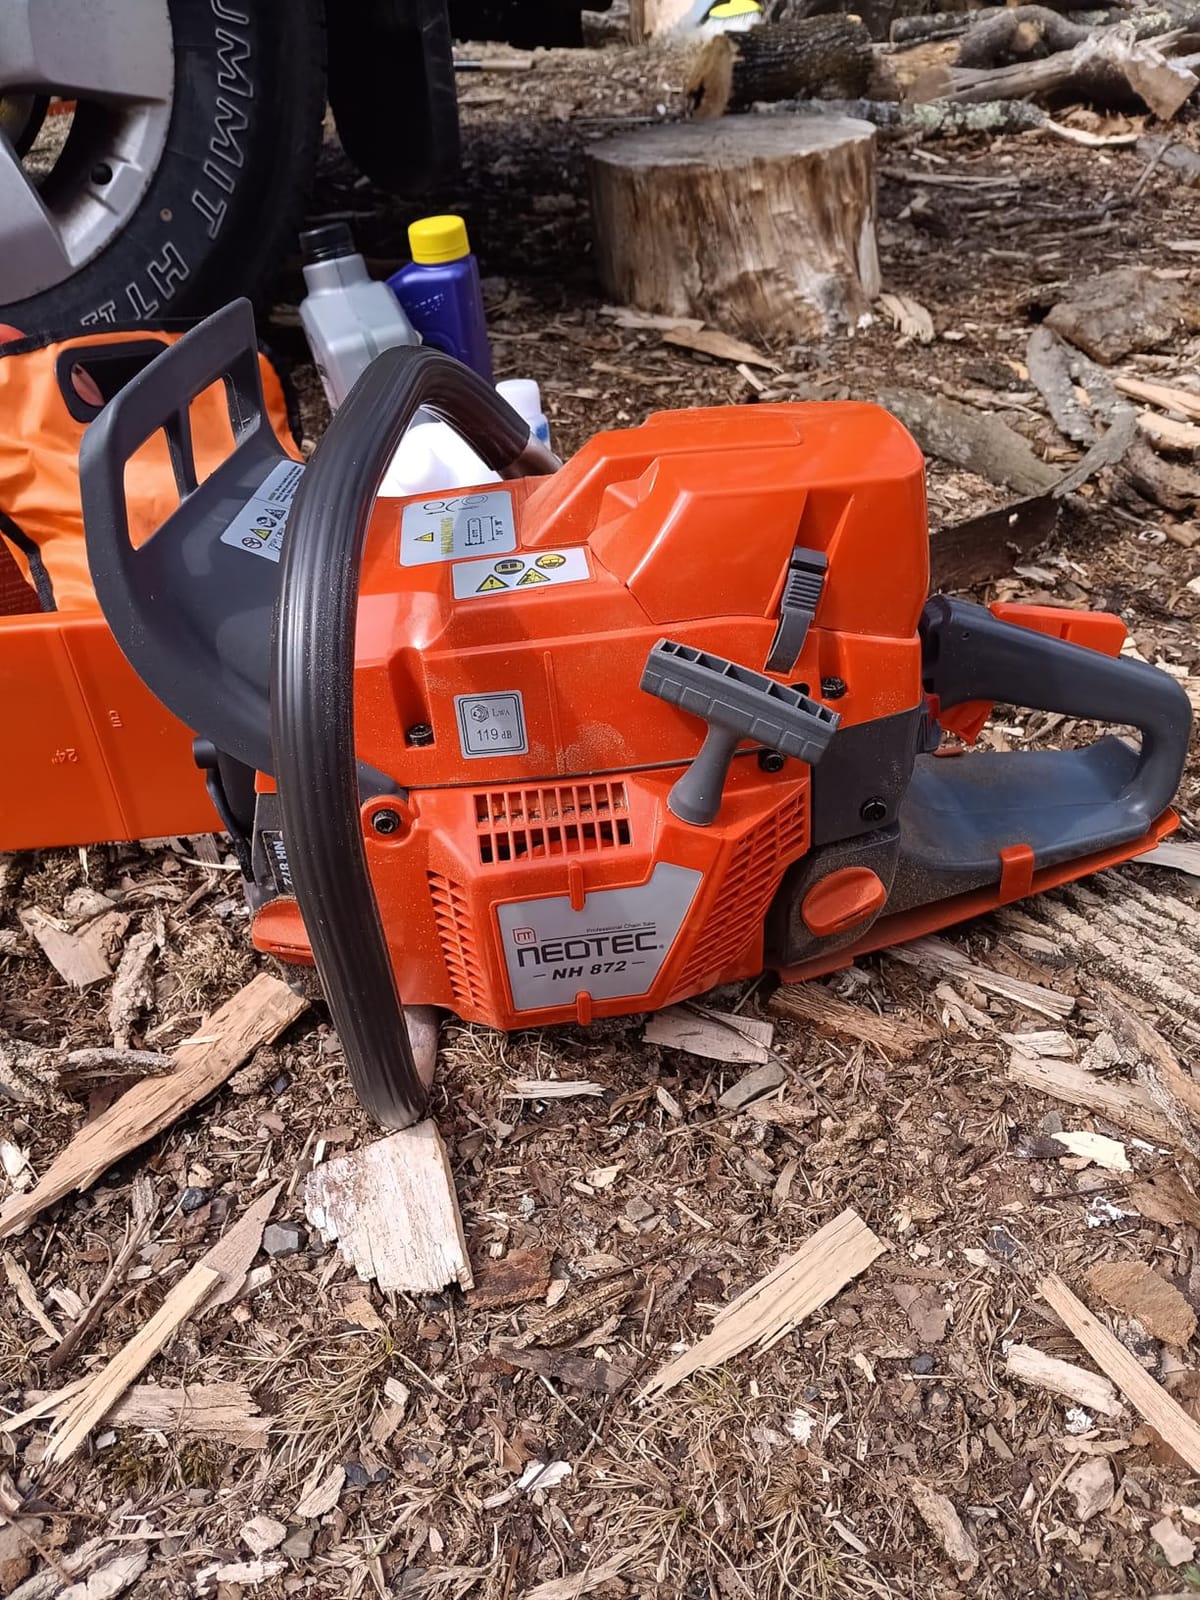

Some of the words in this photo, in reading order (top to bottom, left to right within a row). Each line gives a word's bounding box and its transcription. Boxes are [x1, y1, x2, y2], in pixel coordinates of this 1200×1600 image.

[126, 242, 190, 320] HT
[477, 727, 499, 741] 119
[501, 730, 513, 740] dB
[272, 840, 287, 860] NH
[586, 924, 623, 933] Professional
[623, 921, 641, 929] Chain
[552, 966, 583, 980] NH
[590, 960, 627, 975] 872
